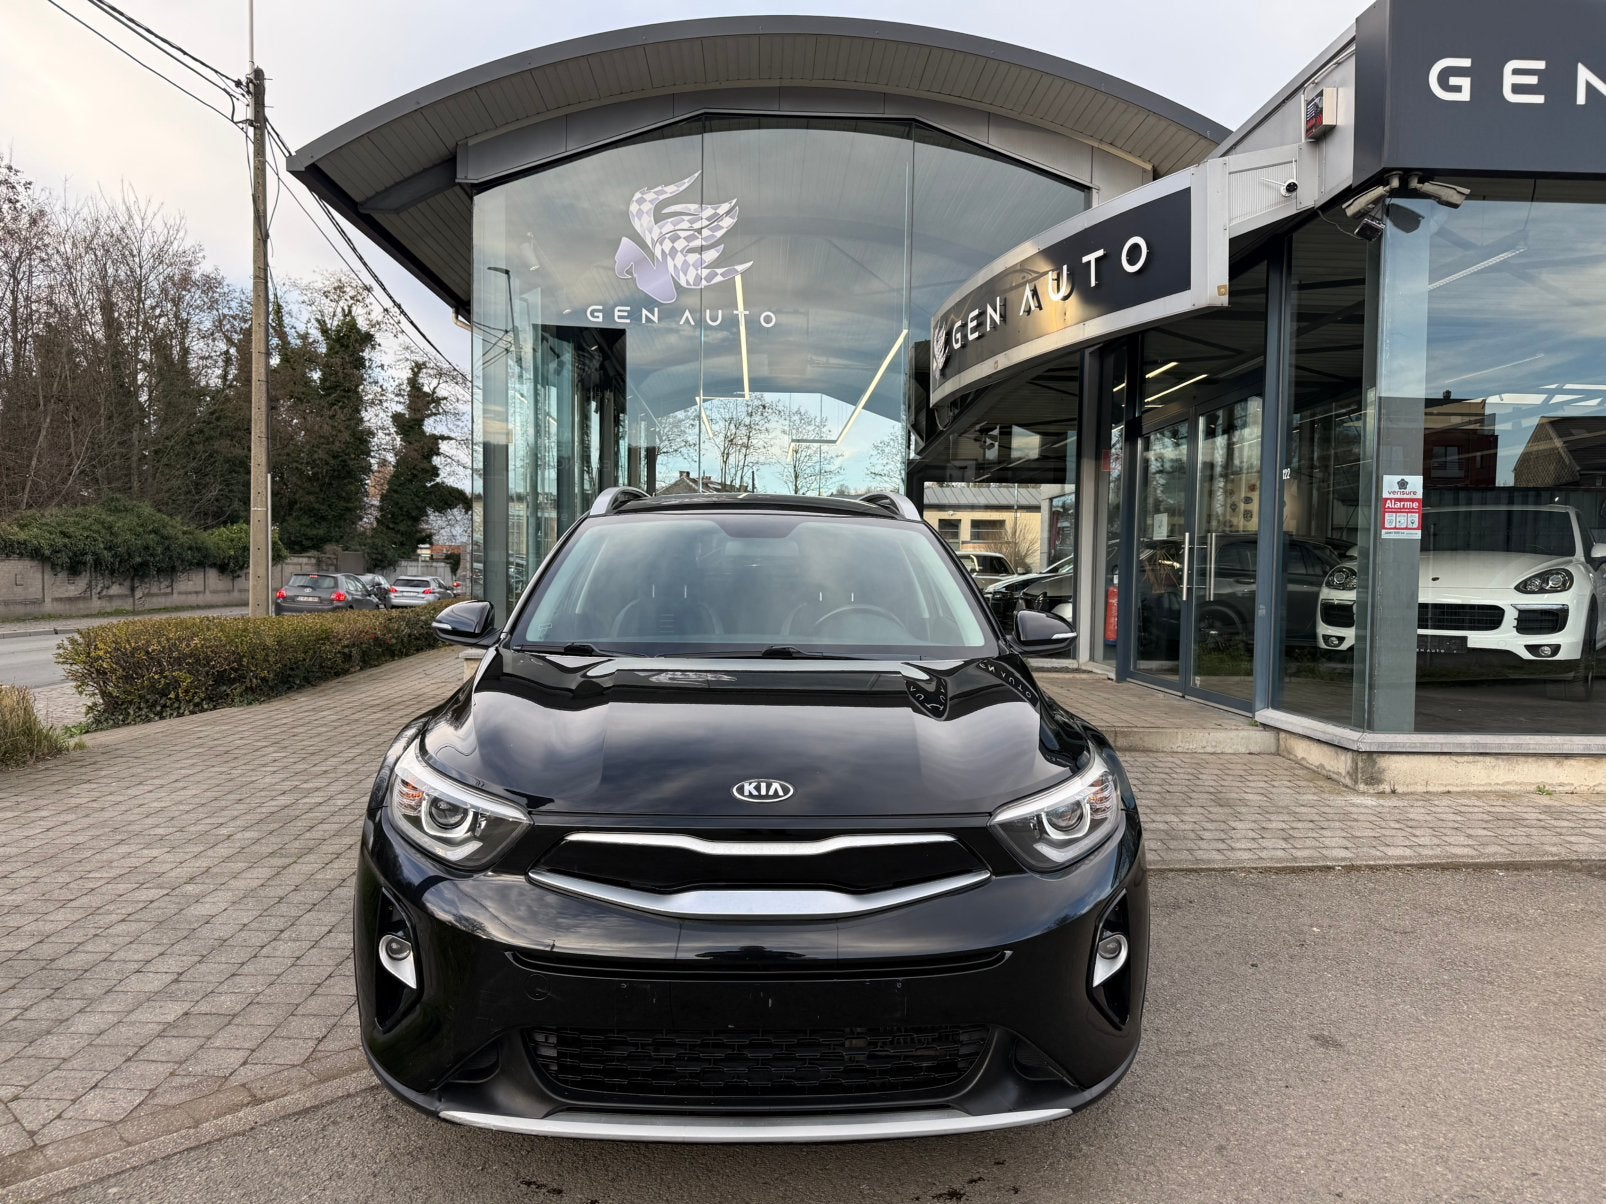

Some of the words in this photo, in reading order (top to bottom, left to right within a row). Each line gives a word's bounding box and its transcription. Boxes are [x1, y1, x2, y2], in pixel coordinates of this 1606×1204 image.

[1428, 57, 1606, 105] GEN
[951, 296, 1001, 350] GEN
[1019, 235, 1148, 316] AUTO
[586, 305, 658, 324] GEN
[679, 309, 776, 328] AUTO
[1385, 499, 1419, 509] Alarme
[743, 782, 784, 796] KIA
